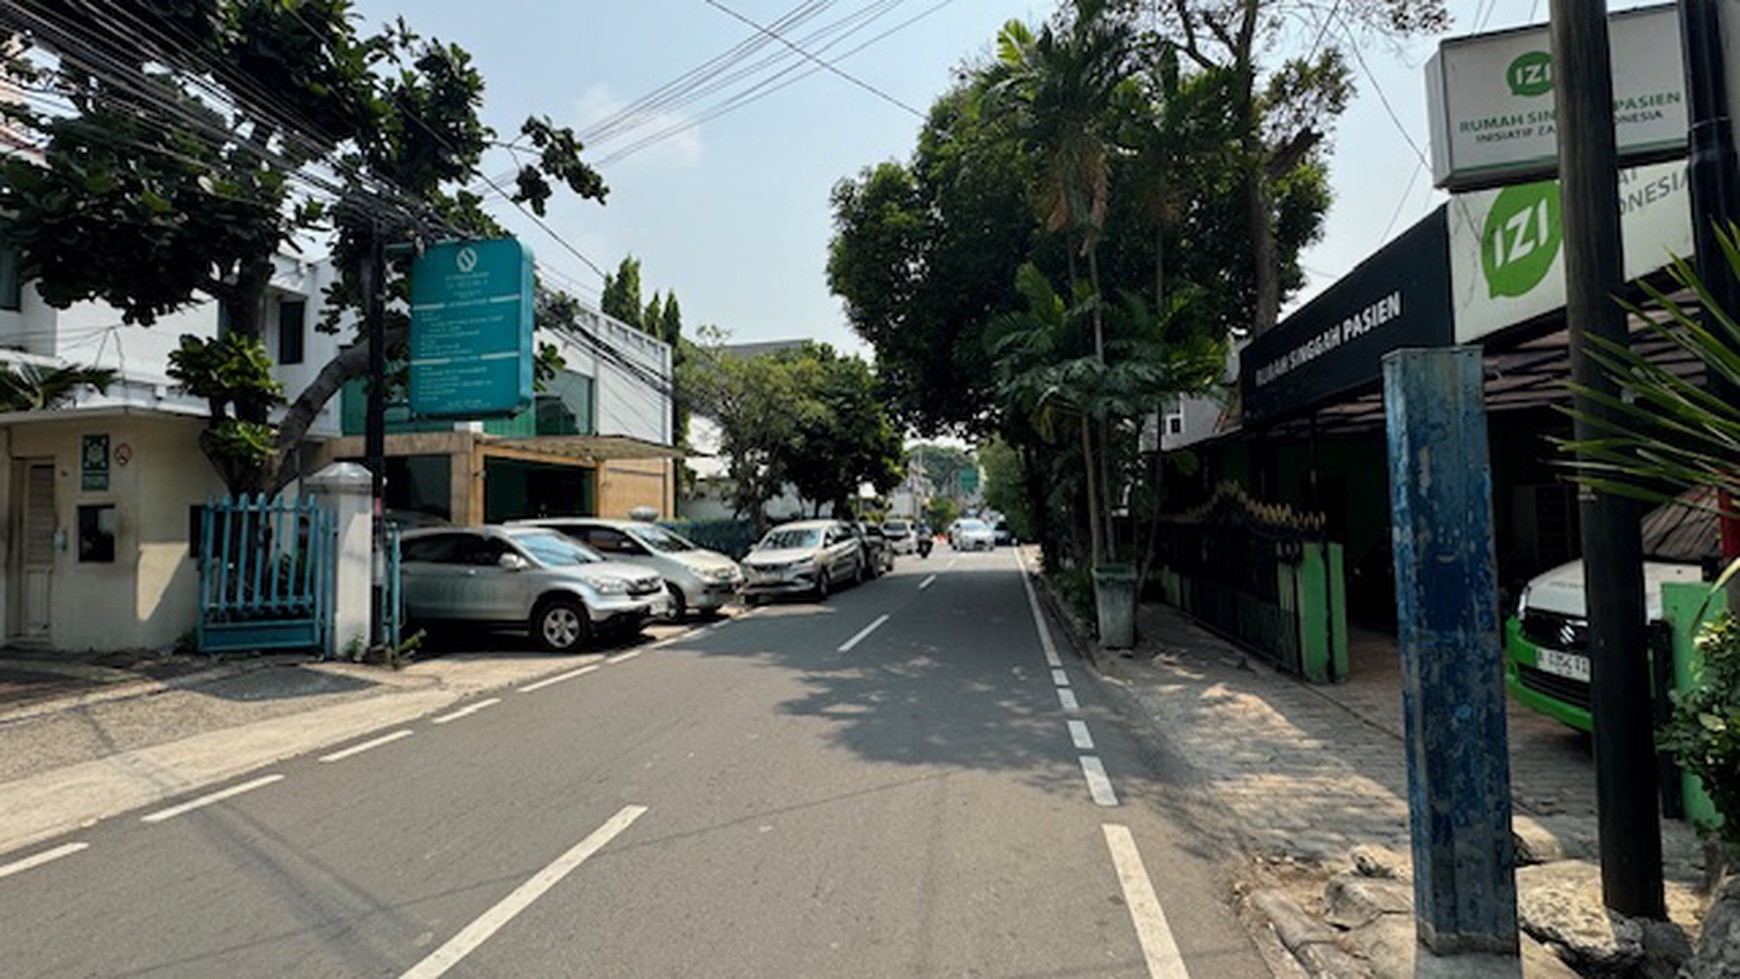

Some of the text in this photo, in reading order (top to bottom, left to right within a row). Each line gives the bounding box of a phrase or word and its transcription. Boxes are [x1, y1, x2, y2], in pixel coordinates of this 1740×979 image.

[1516, 63, 1551, 85] IZI
[1460, 114, 1523, 132] RUMAH
[1613, 92, 1682, 111] PASIEN
[1495, 198, 1549, 269] IZI
[1343, 290, 1401, 343] PASIEN
